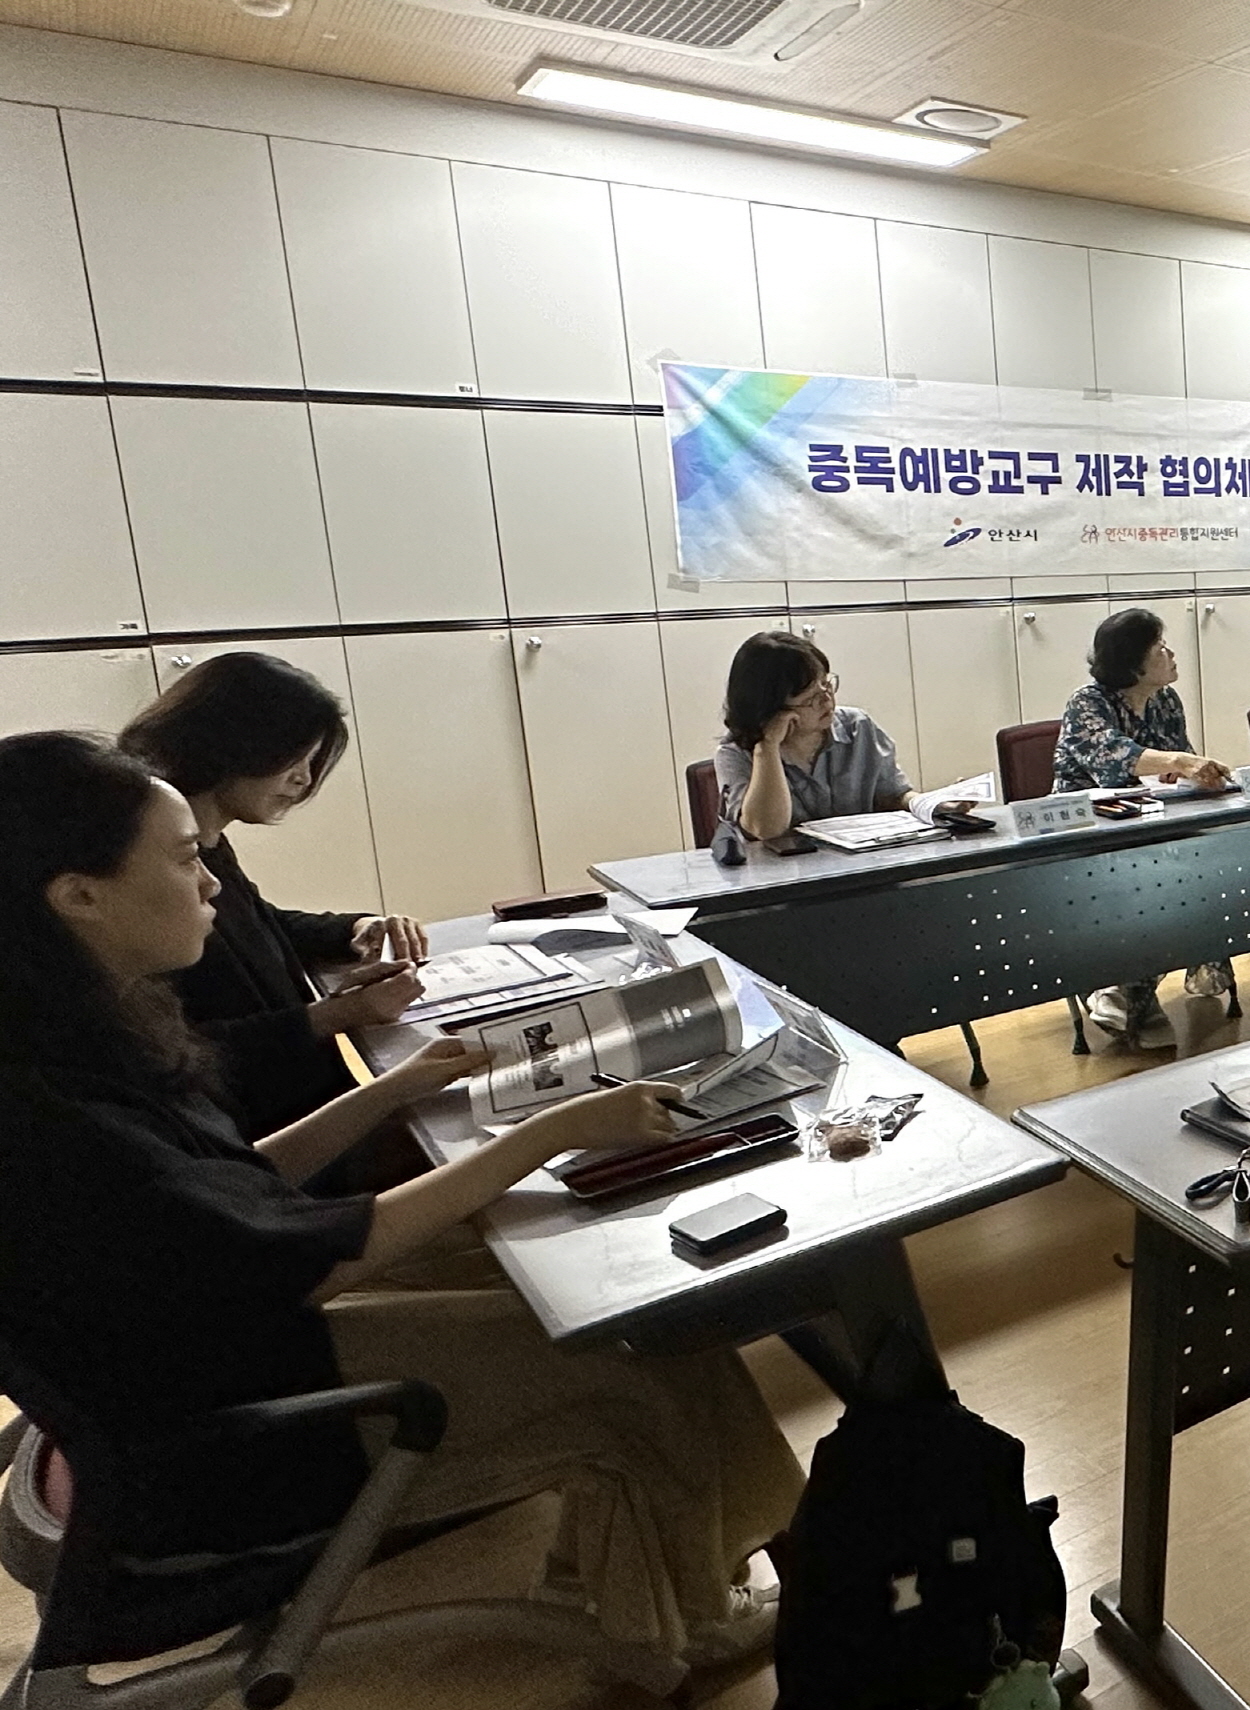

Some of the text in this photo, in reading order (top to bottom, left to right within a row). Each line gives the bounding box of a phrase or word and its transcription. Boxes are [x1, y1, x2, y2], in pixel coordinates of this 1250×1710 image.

[807, 443, 1062, 495] 중독예방교구
[1074, 453, 1148, 497] 제작
[987, 528, 1039, 543] 안산시
